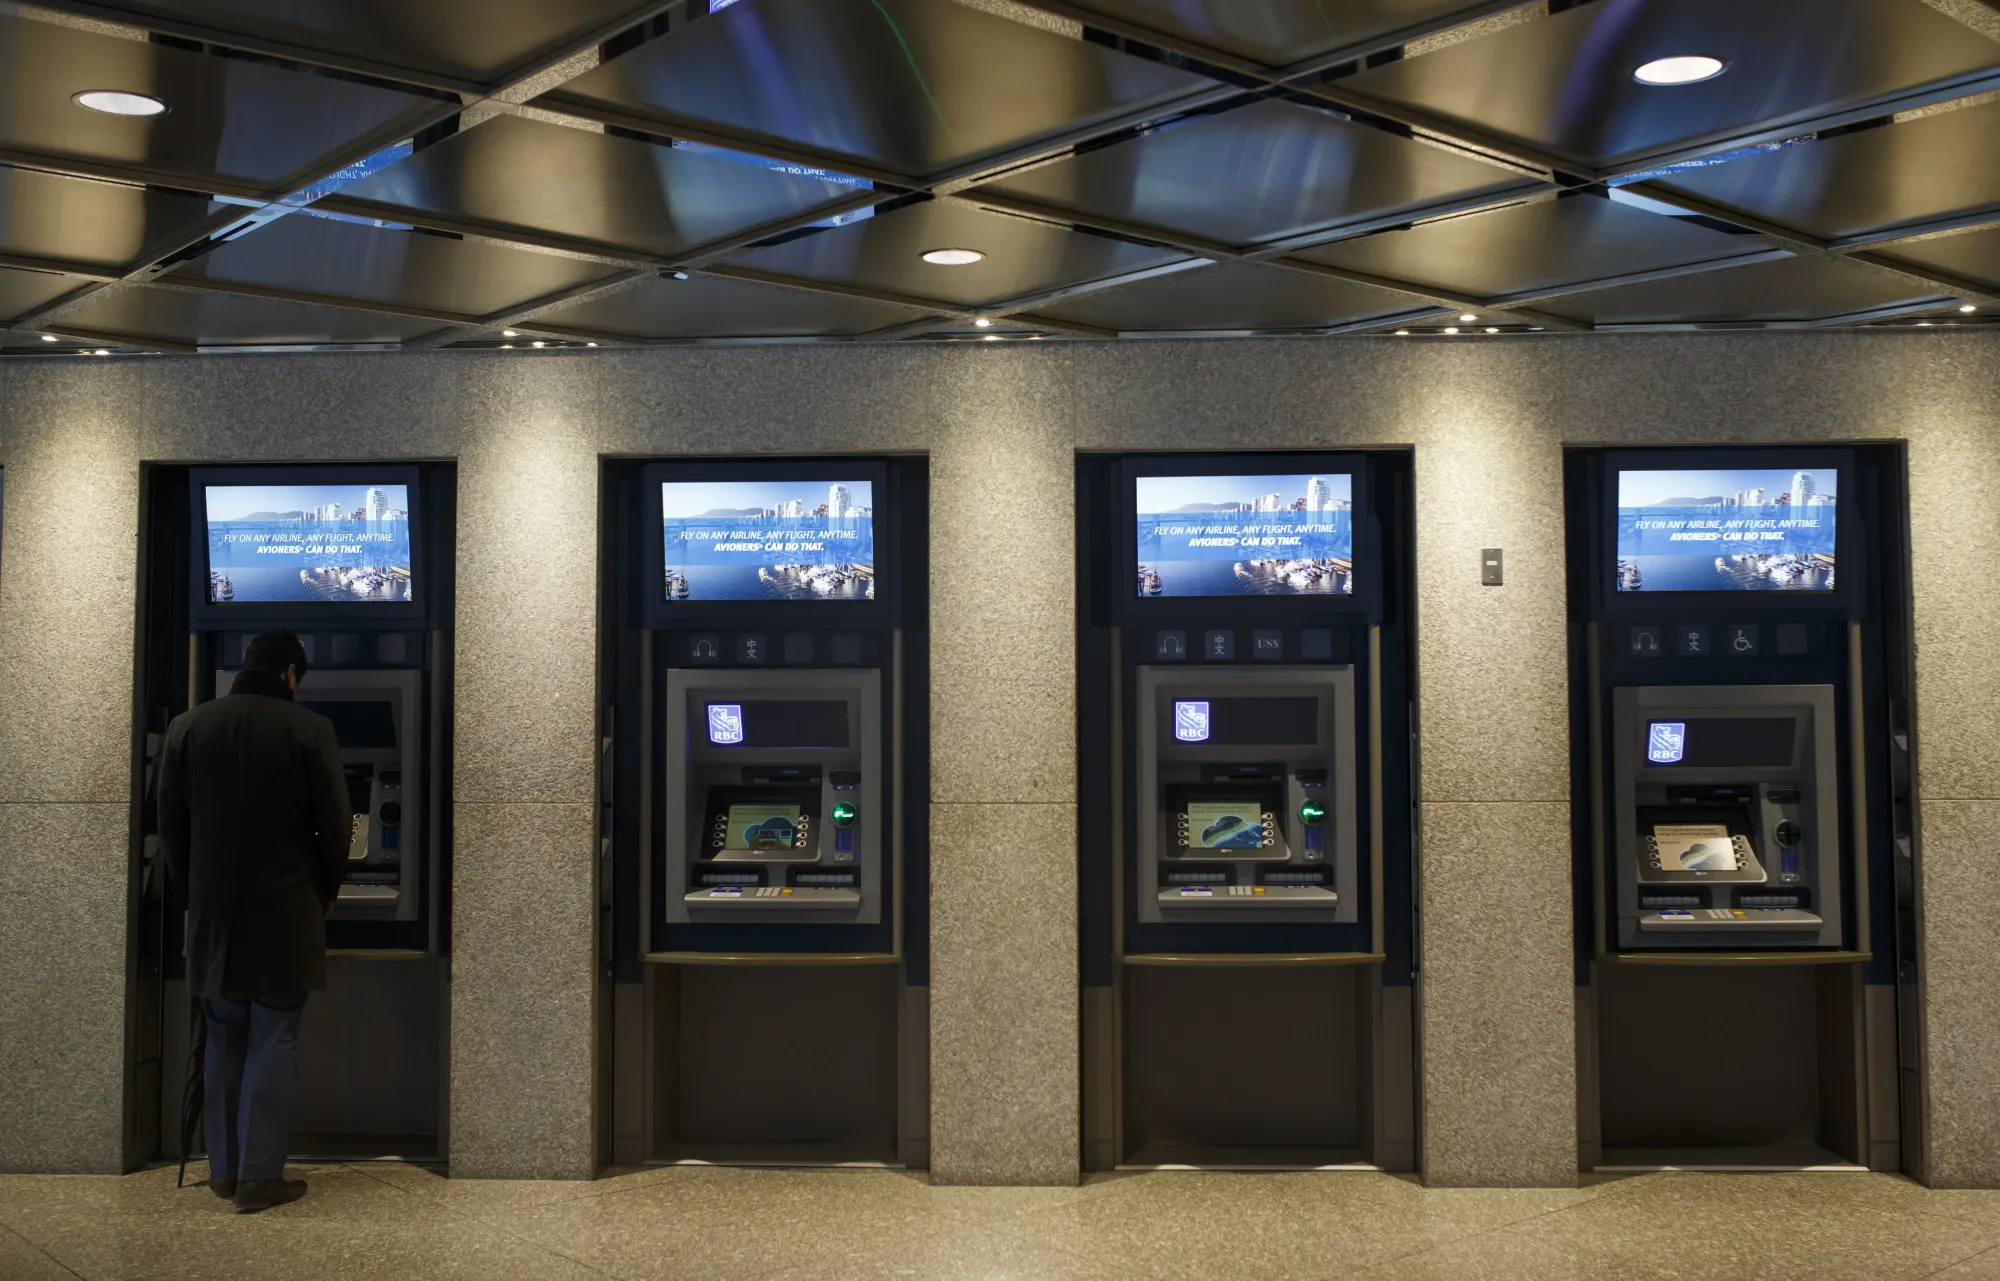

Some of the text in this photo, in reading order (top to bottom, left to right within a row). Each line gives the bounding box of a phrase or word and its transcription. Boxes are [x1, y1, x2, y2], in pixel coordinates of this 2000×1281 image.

[1154, 524, 1336, 535] FLY ON ANY AIRLINE, ANY FLIGHT, ANYTIME.
[1636, 520, 1820, 530] FLY ON ANY AIRLINE, ANY FLIGHT, ANYTIME.
[224, 534, 395, 543] FLY ON ANY AIRLINE, ANY FLIGHT, ANYTIME.
[681, 530, 857, 540] FLY ON ANY AIRLINE, ANY FLIGHT, ANYTIME.
[1723, 532, 1741, 541] CAN
[1744, 532, 1758, 541] DO
[1760, 532, 1784, 541] THAT.
[1241, 537, 1260, 547] CAN
[1261, 537, 1275, 547] DO
[1277, 537, 1301, 547] THAT.
[306, 545, 323, 554] CAN
[325, 545, 338, 554] DO
[340, 545, 362, 554] THAT.
[765, 543, 783, 551] CAN
[785, 543, 798, 551] DO
[800, 543, 824, 551] THAT.
[714, 731, 739, 740] RBC
[1180, 729, 1205, 737] RBC
[1653, 750, 1678, 759] RBC
